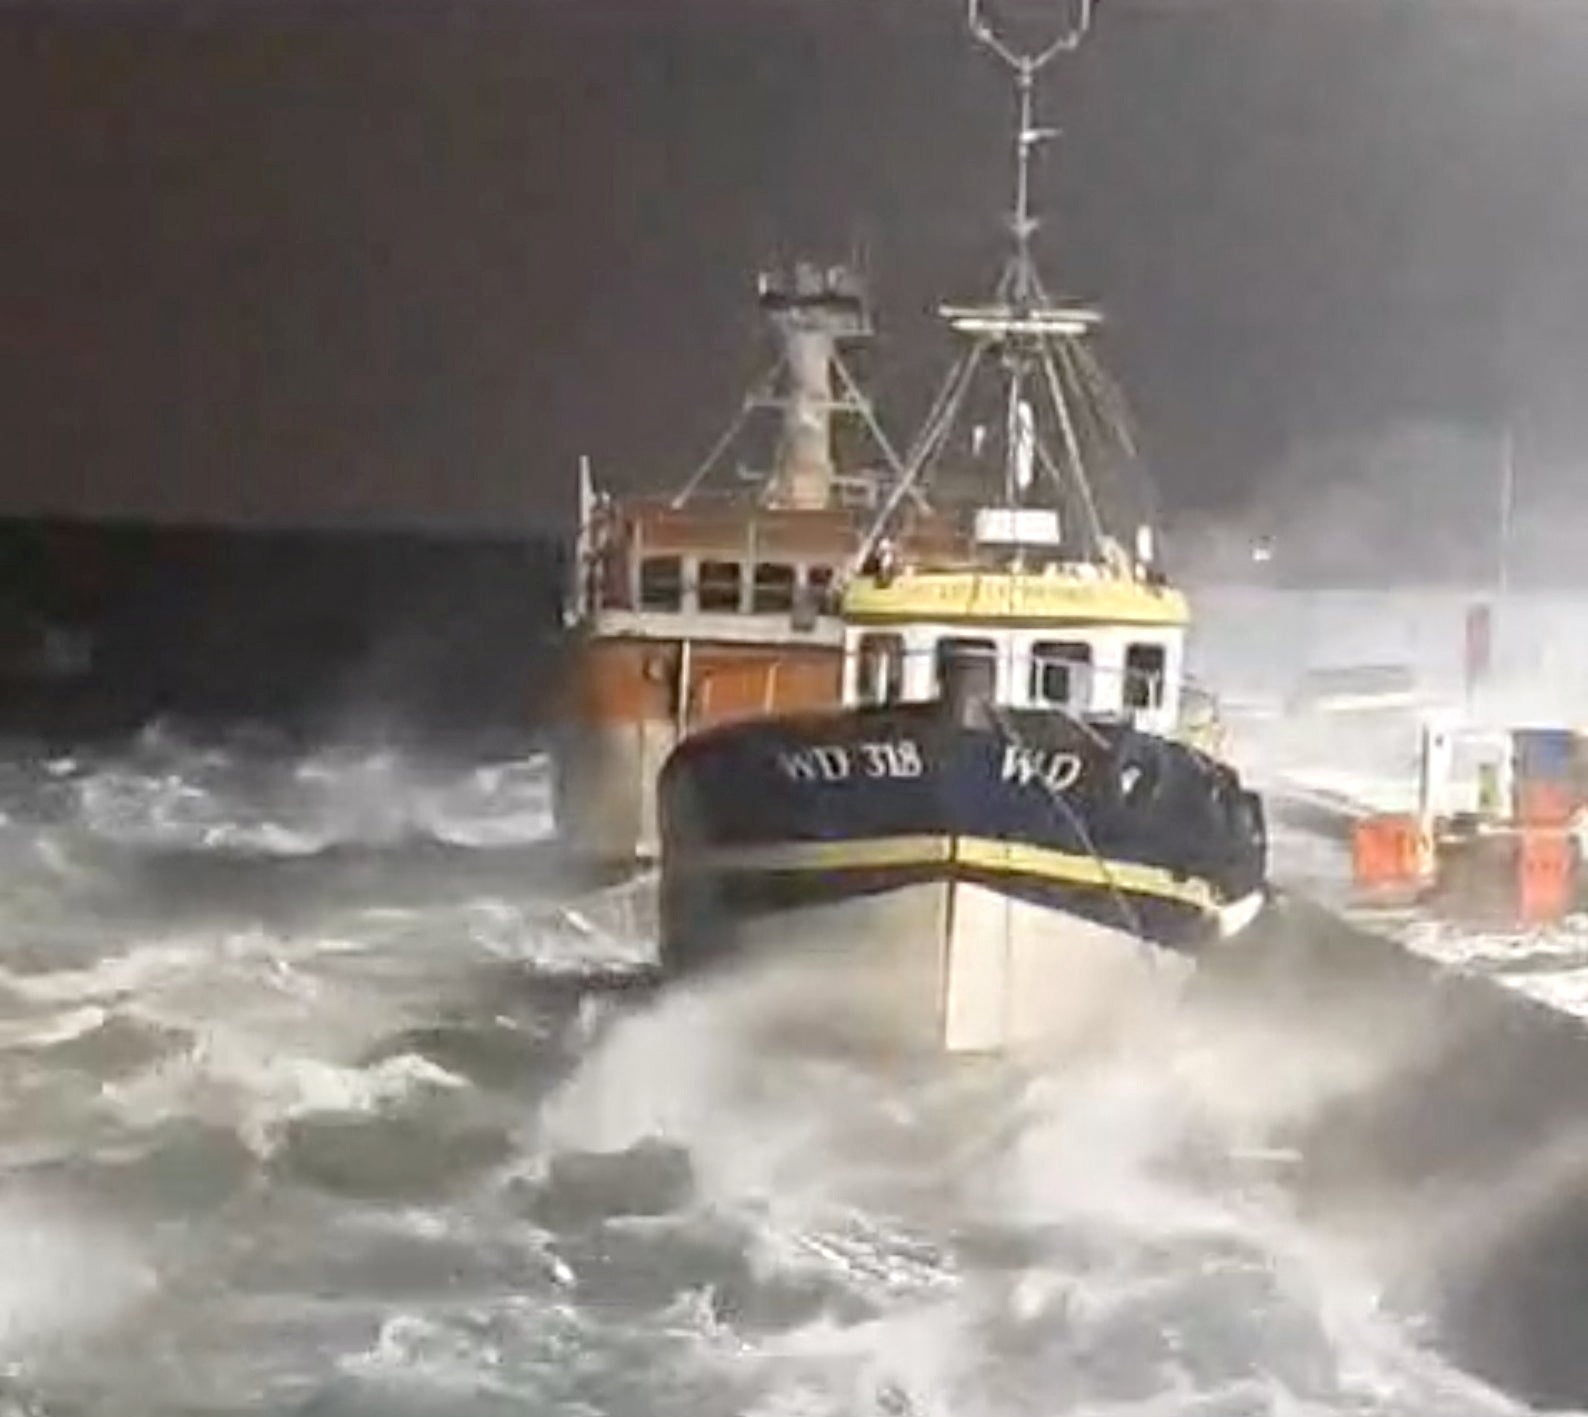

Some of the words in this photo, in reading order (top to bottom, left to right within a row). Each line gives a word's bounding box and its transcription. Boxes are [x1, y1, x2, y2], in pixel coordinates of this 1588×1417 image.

[778, 746, 849, 781] WD
[861, 740, 923, 778] 318
[1002, 746, 1081, 791] WD
